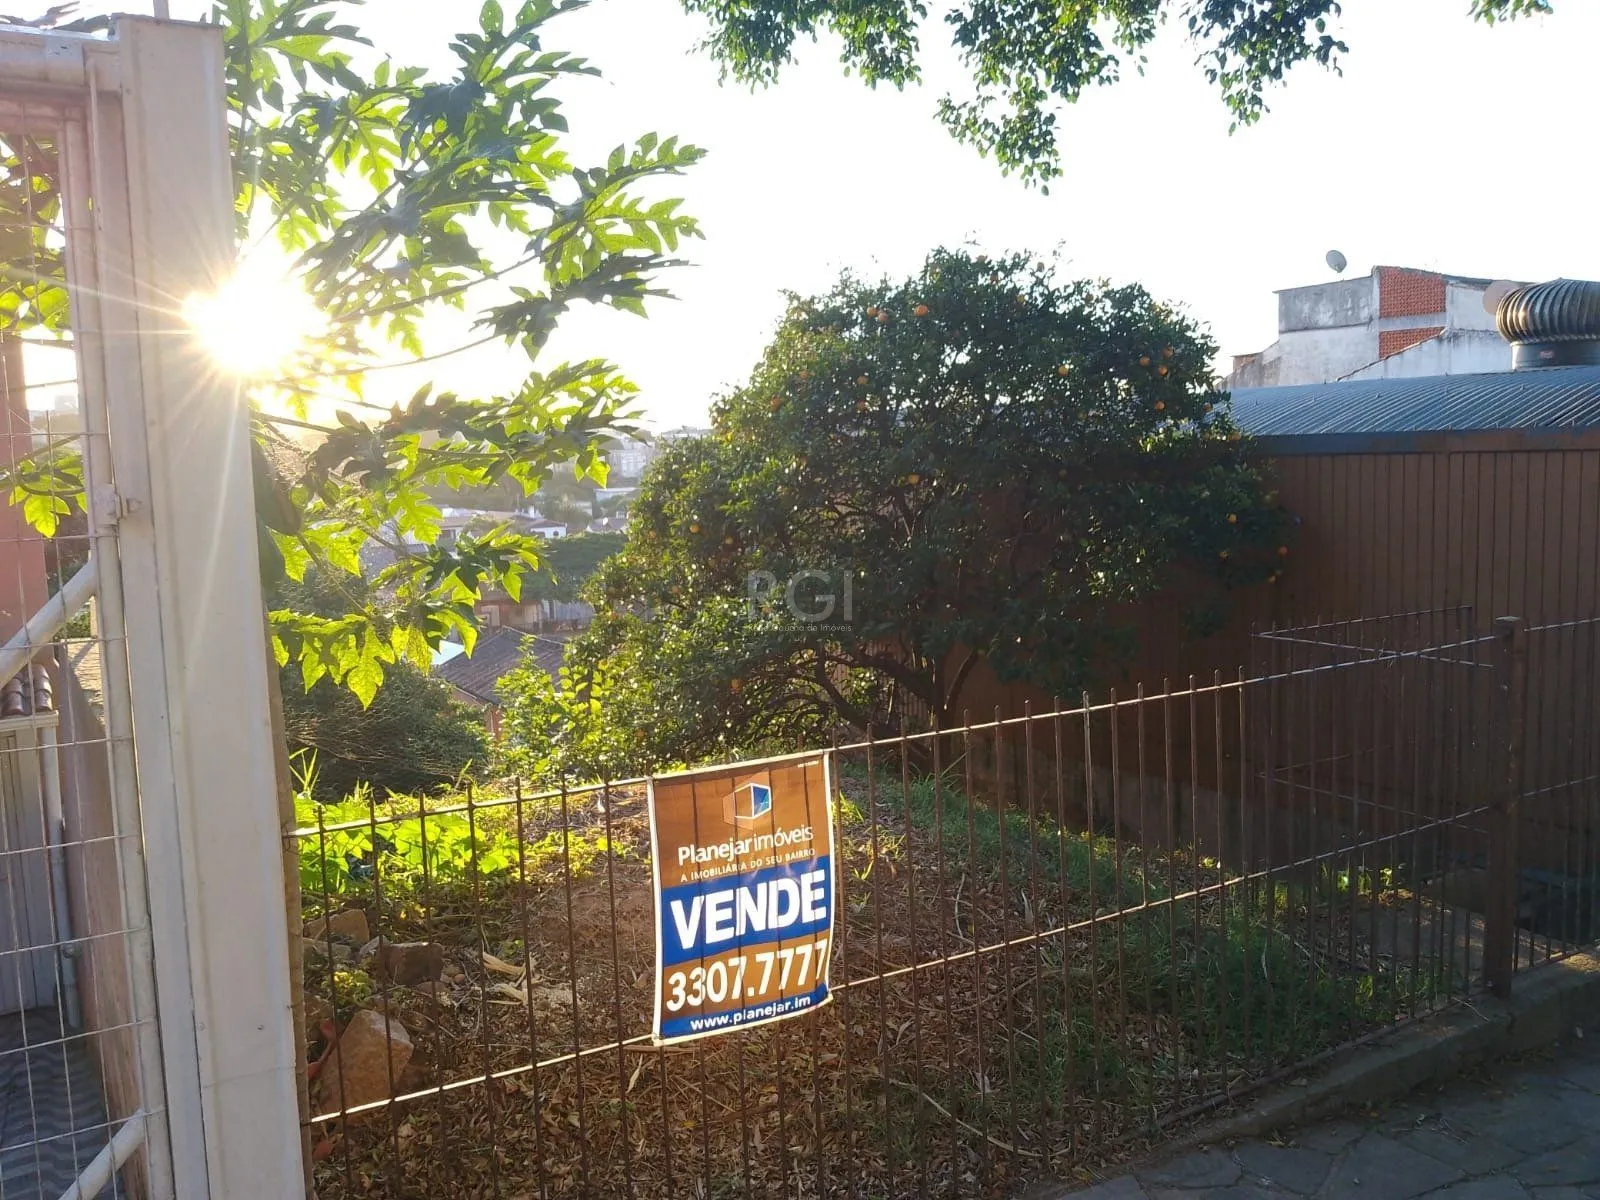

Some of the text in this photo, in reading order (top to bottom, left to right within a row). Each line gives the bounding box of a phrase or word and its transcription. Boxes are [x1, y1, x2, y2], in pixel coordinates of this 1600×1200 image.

[680, 873, 688, 883] A
[750, 859, 763, 869] DO
[765, 854, 783, 866] SEU
[785, 848, 816, 862] BAIRRO
[670, 869, 828, 950] VENDE
[666, 938, 828, 1012] 3307.7777
[690, 996, 812, 1031] www.planejar.im
